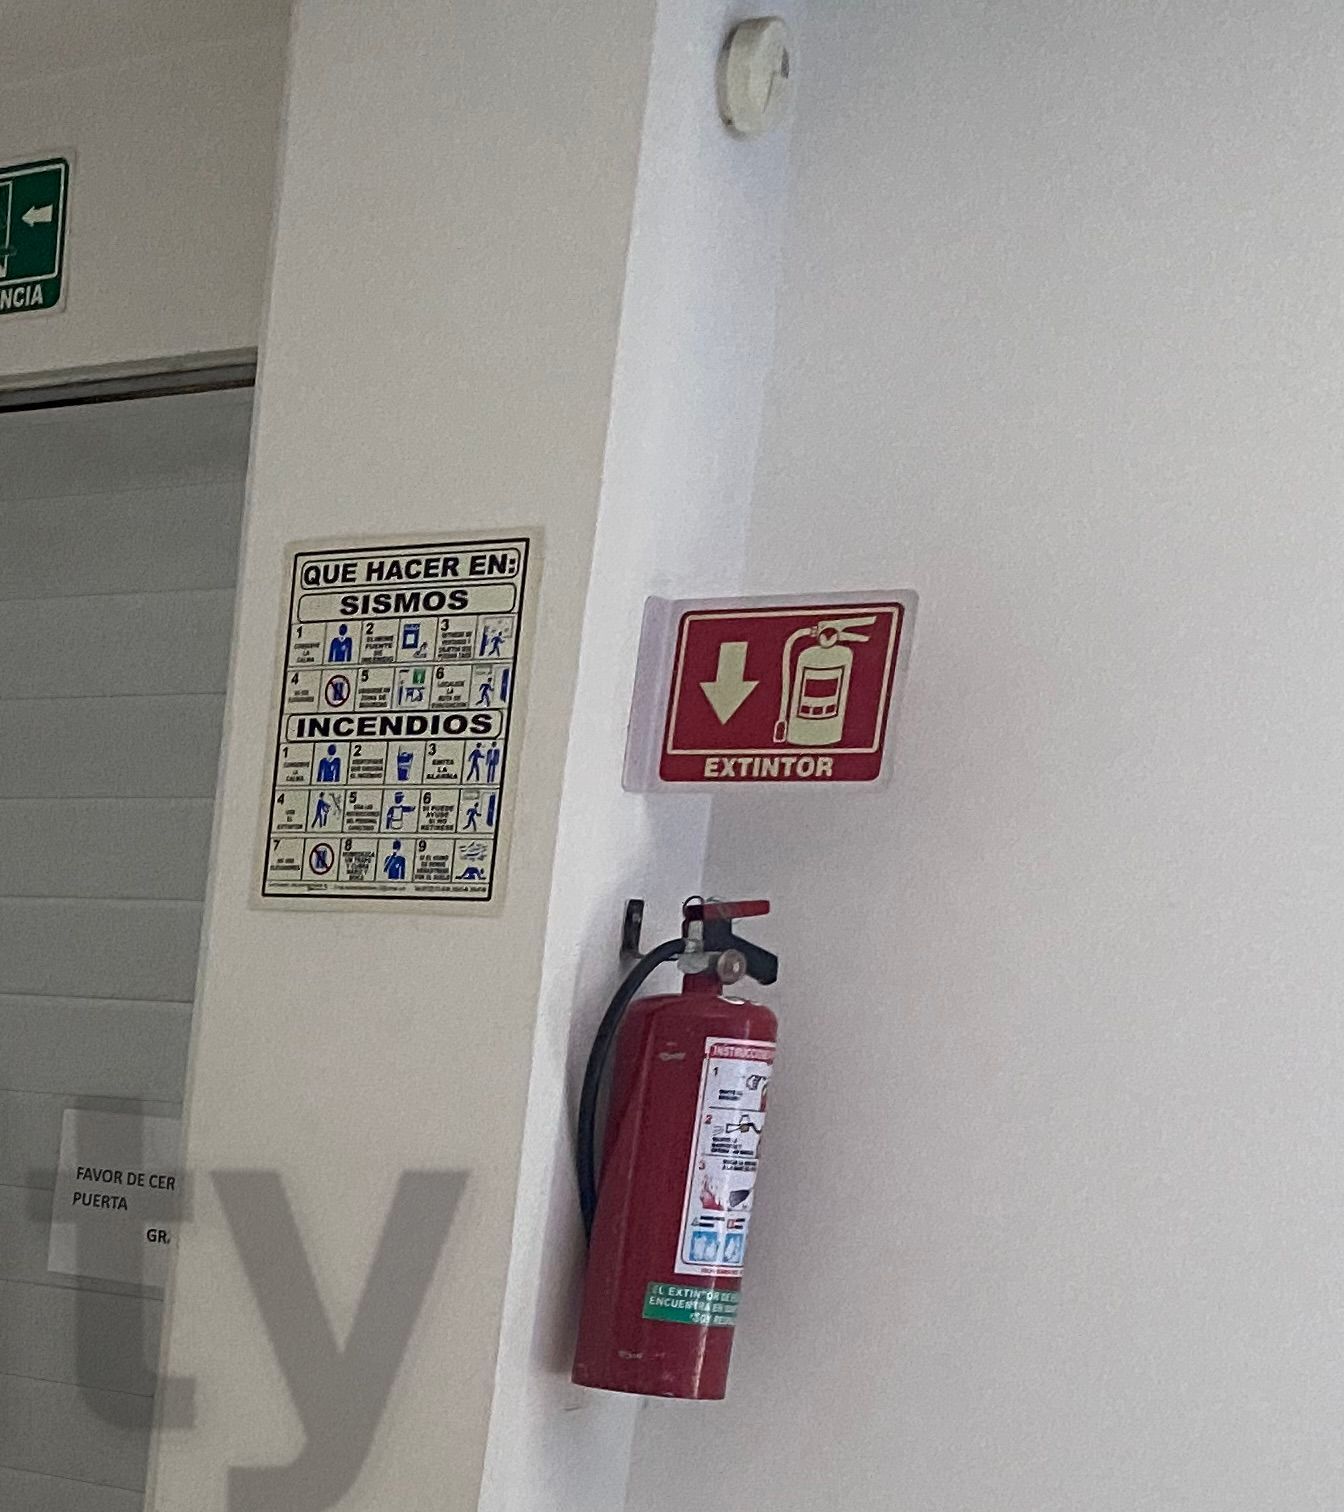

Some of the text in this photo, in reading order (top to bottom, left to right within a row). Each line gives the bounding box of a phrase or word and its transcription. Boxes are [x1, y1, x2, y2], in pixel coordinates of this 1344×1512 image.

[303, 553, 517, 587] QUE HACER EN:
[339, 589, 469, 616] SISMOS
[366, 622, 375, 635] 2
[440, 618, 450, 631] 3
[296, 625, 303, 639] 1
[291, 672, 299, 685] 4
[361, 669, 370, 682] 5
[436, 666, 445, 679] 6
[296, 713, 494, 739] INCENDIOS
[282, 746, 289, 758] 1
[353, 744, 362, 757] 2
[428, 743, 437, 756] 3
[703, 756, 834, 777] EXTINTOR
[277, 793, 285, 805] 4
[349, 791, 357, 804] 5
[423, 791, 432, 804] 6
[273, 839, 281, 851] 7
[344, 838, 353, 851] 8
[418, 839, 427, 852] 9
[713, 1066, 719, 1076] 1
[76, 1166, 123, 1185] FAVOR
[126, 1172, 145, 1187] DE
[72, 1191, 128, 1211] PUERTA
